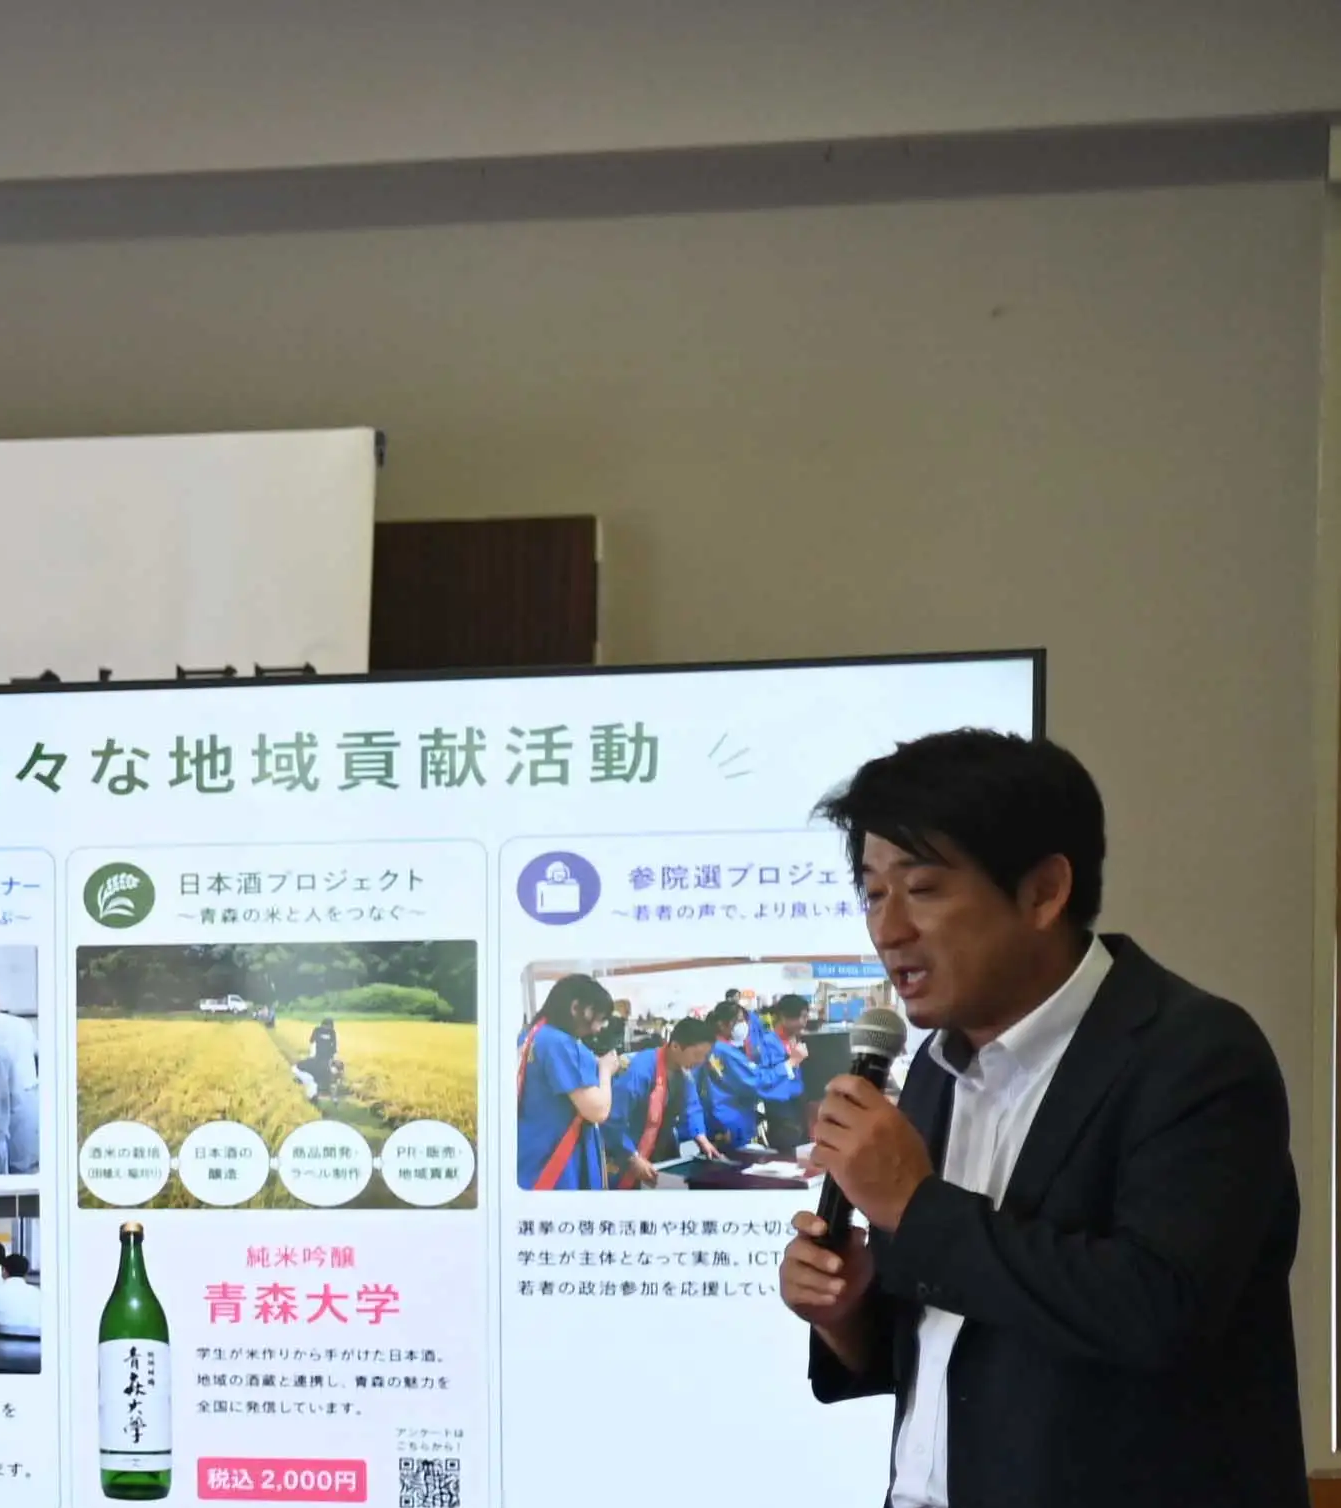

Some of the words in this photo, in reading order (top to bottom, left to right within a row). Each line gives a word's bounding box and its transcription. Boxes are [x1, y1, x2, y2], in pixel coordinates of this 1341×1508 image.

[180, 868, 424, 896] 日本酒プロジェクト
[195, 1146, 253, 1159] 日本酒の
[292, 1167, 360, 1180] ラベル制作
[398, 1167, 458, 1180] 地域貢献
[246, 1246, 355, 1269] 純米吟醸
[204, 1282, 400, 1325] 青森大学
[196, 1347, 442, 1363] 学生が米作りから手がけた日本酒。
[197, 1373, 447, 1389] 地域の酒蔵と連携し、青森の魅力を
[198, 1400, 361, 1415] 全国に発信しています。
[207, 1467, 254, 1490] 税込
[261, 1469, 357, 1492] 2,000円
